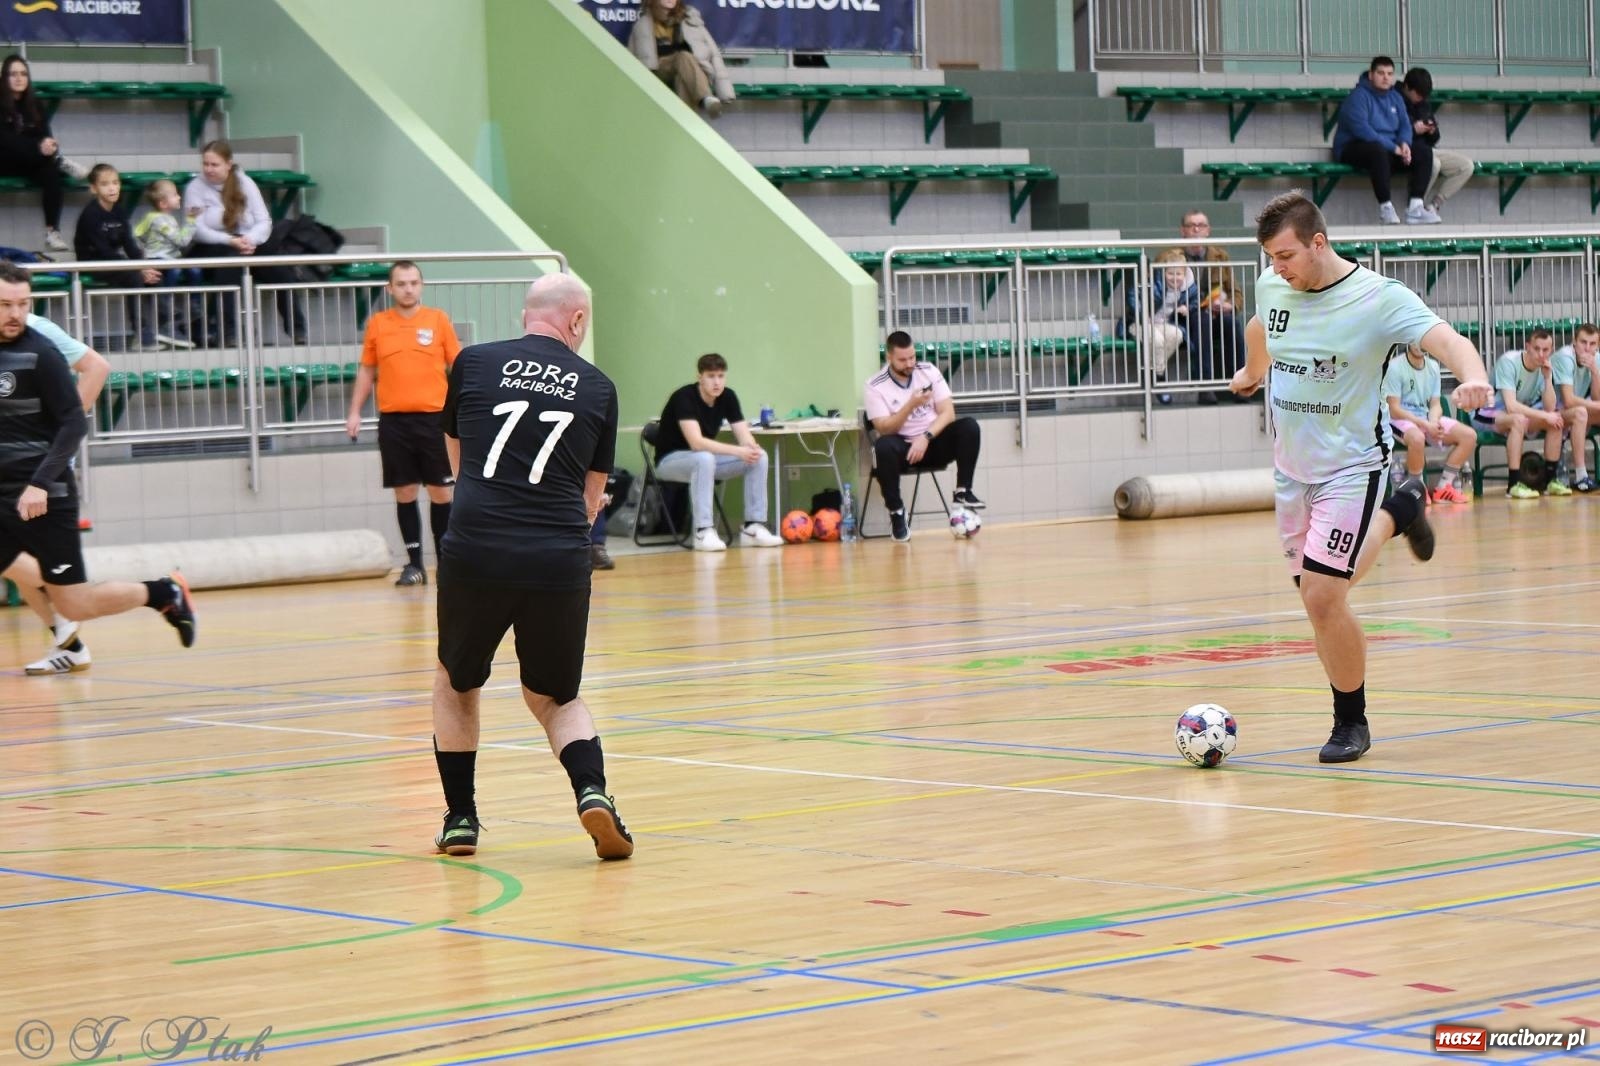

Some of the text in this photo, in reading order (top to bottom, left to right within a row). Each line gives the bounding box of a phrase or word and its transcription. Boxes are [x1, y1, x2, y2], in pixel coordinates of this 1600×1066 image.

[597, 8, 641, 23] RACIB
[1268, 308, 1290, 333] 99
[502, 359, 579, 388] ODRA
[499, 377, 577, 401] RACIBÓRZ
[1326, 528, 1354, 554] 99
